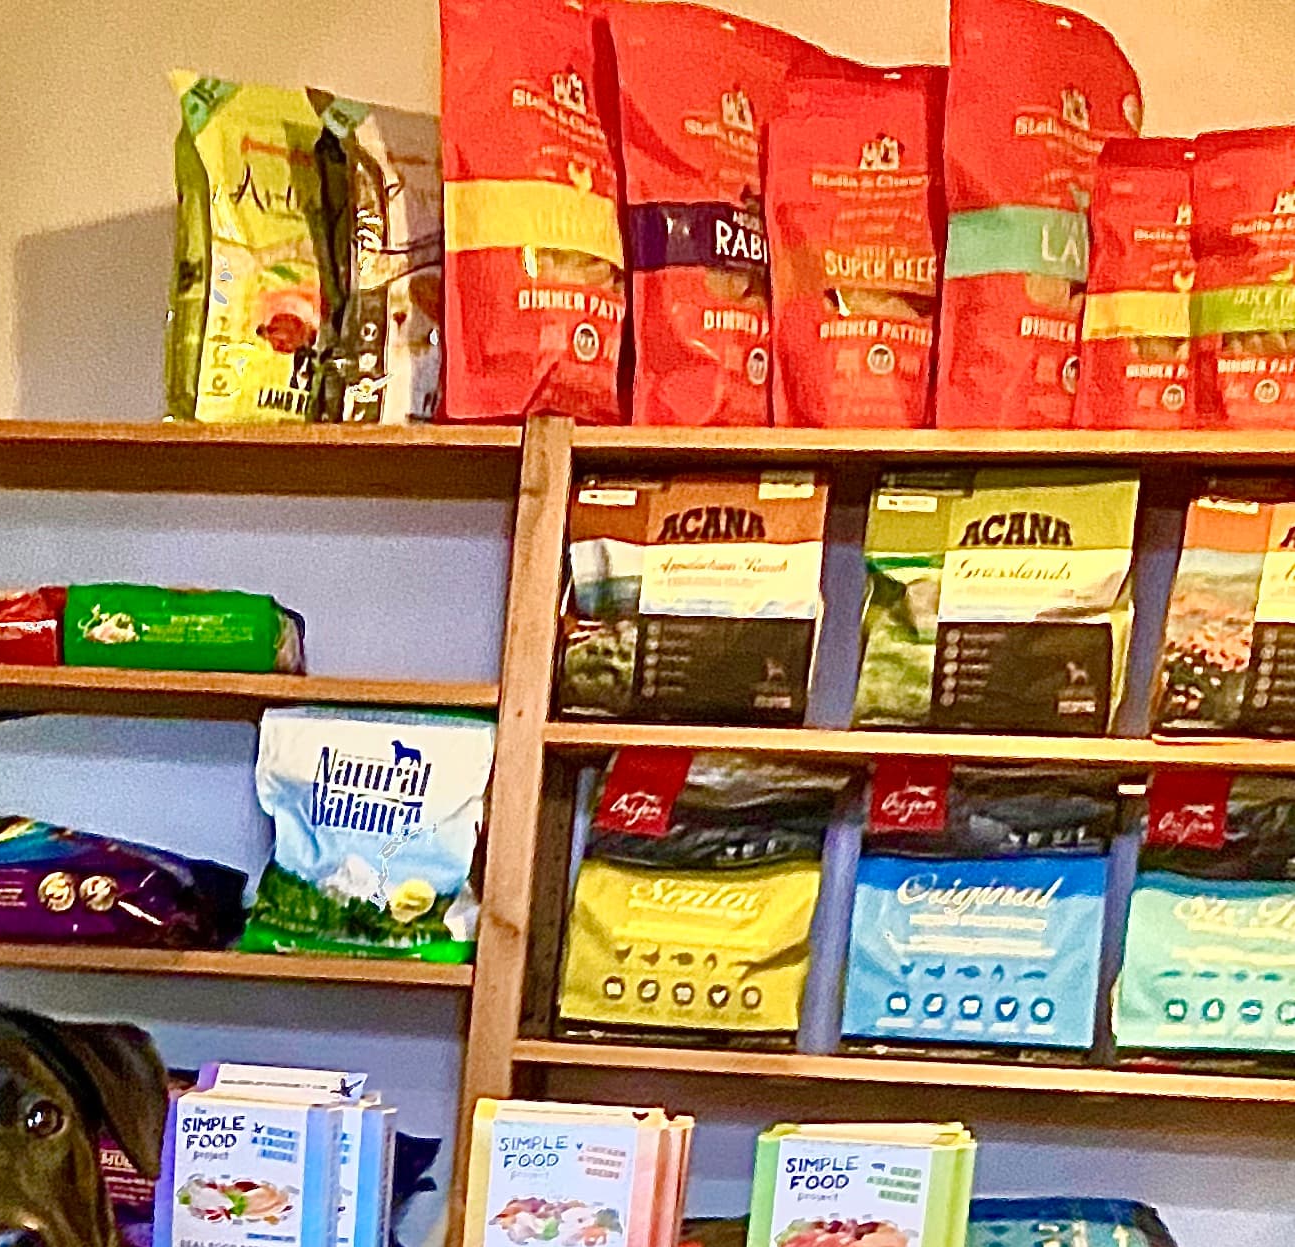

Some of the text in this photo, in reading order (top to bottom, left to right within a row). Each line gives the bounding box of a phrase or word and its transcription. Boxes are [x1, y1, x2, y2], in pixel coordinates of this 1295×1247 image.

[824, 248, 886, 281] SUPER
[518, 288, 585, 311] DINNER
[819, 319, 878, 339] DINNER
[656, 506, 767, 541] ACANA
[958, 511, 1074, 546] ACANA
[953, 559, 1072, 581] Grasslands
[313, 746, 433, 797] Natural
[896, 872, 1066, 918] Original
[181, 1115, 246, 1133] SIMPLE
[186, 1133, 237, 1150] FOOD
[498, 1135, 569, 1152] SIMPLE
[503, 1153, 560, 1168] FOOD
[785, 1155, 860, 1174] SIMPLE
[789, 1174, 850, 1190] FOOD
